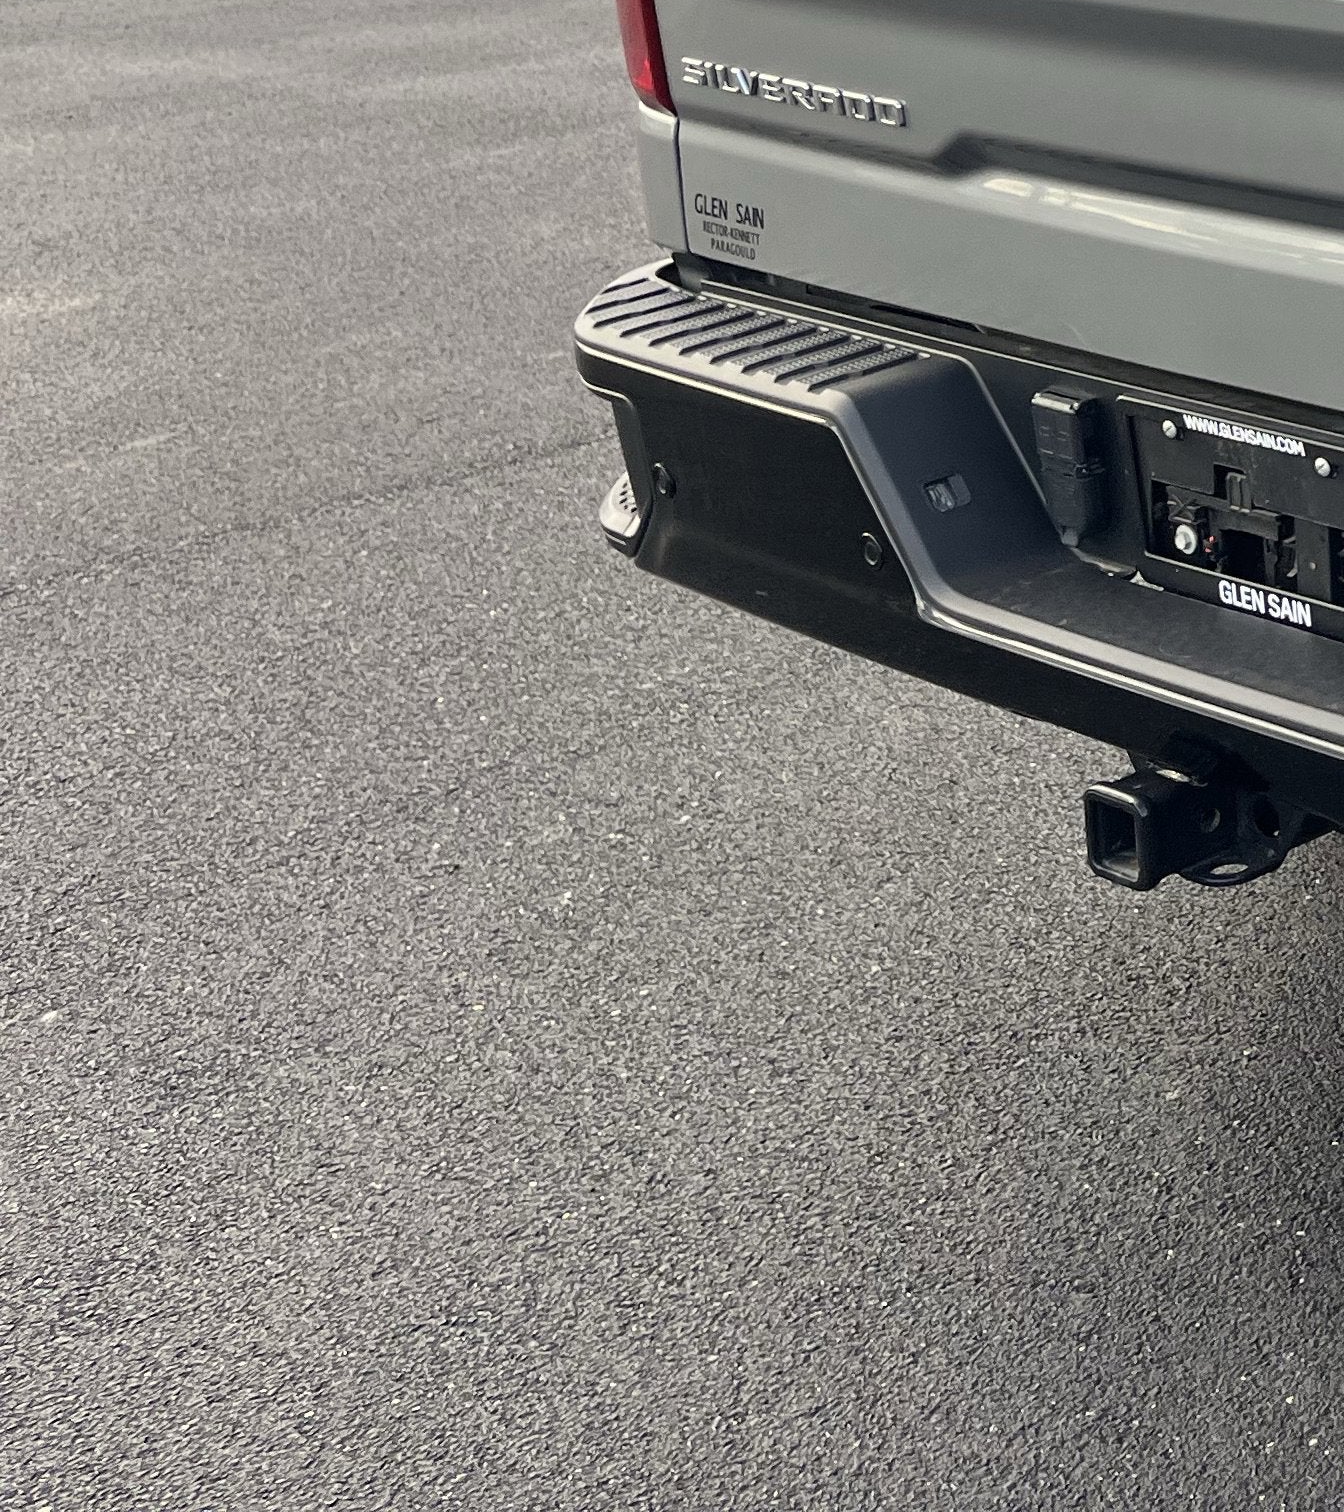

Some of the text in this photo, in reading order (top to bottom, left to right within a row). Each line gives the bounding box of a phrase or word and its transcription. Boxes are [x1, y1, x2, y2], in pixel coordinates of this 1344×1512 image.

[681, 56, 907, 127] SILVERADO
[695, 193, 764, 230] GLEN SAIN
[711, 238, 756, 260] PARAGOULD
[1182, 413, 1306, 457] WWW.GLENSAIN.COM
[1218, 579, 1313, 628] GLEN SAIN
